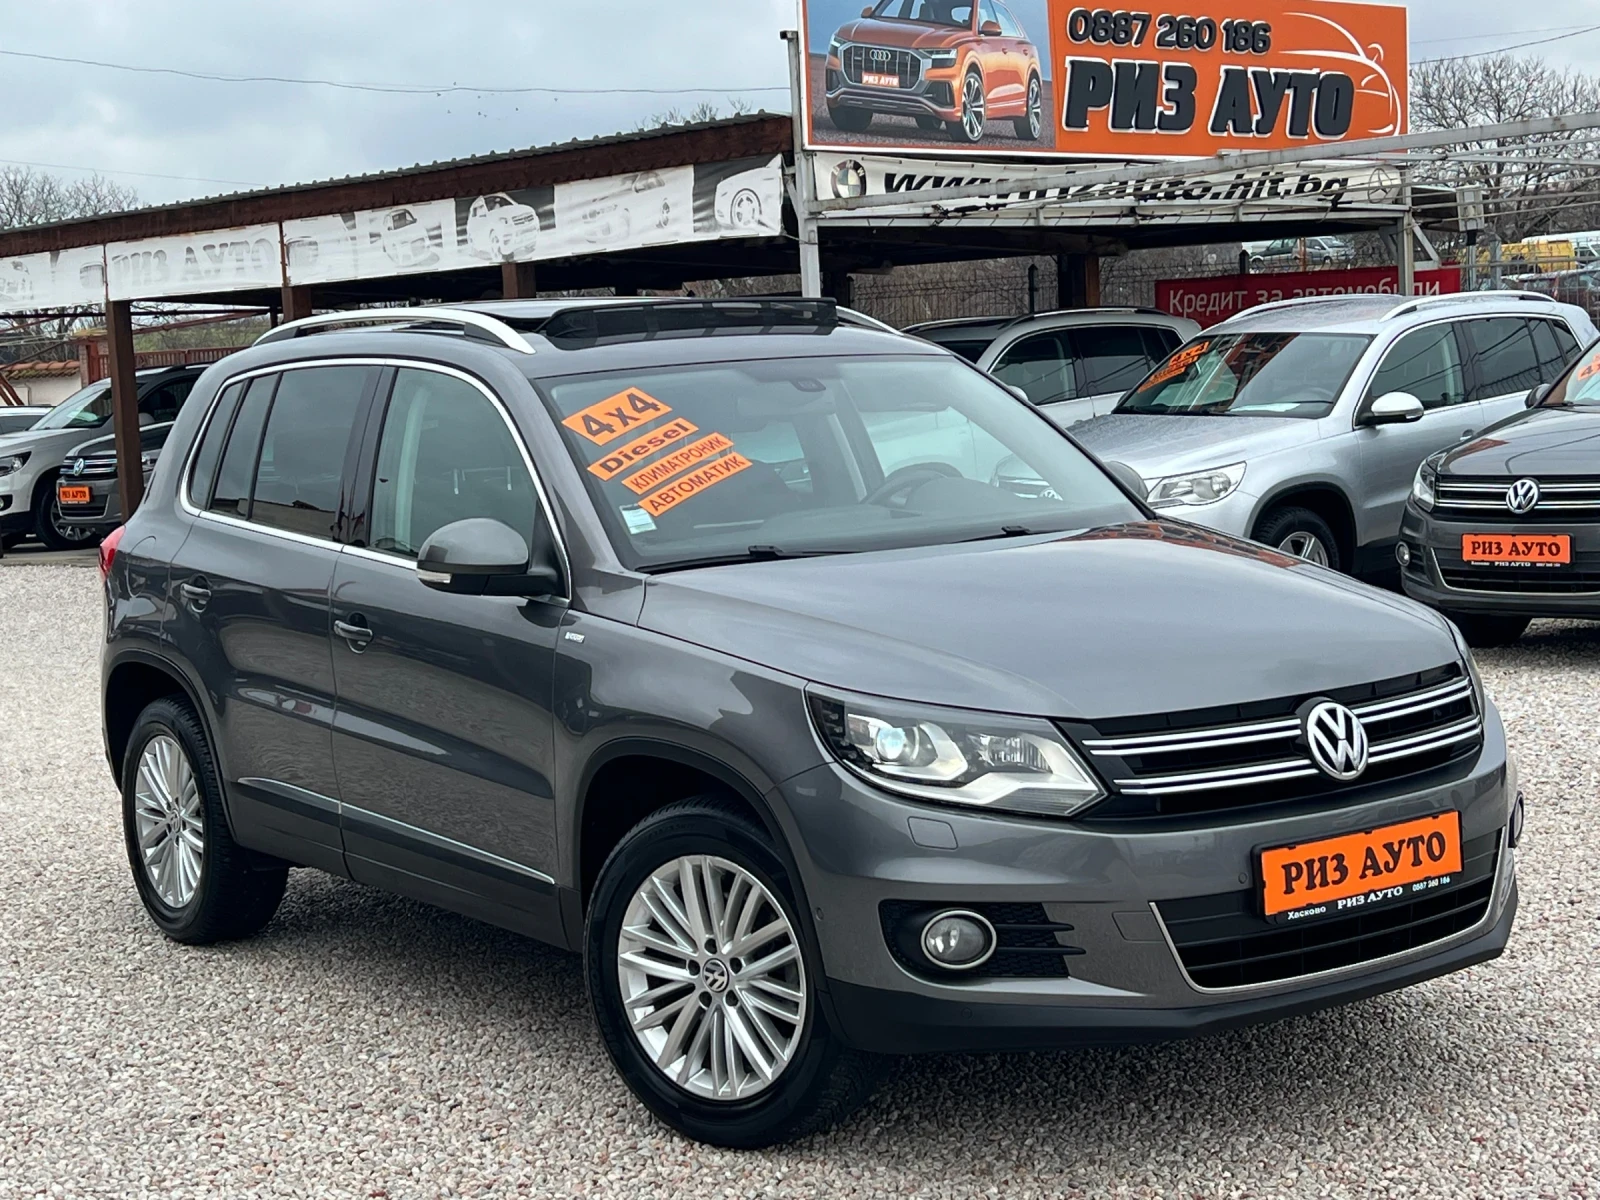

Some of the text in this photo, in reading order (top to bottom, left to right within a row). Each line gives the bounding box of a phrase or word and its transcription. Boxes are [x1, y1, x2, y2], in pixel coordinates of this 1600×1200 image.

[1068, 8, 1272, 55] 0887 260 186
[1062, 56, 1354, 140] РИЗ АУТО
[1169, 289, 1248, 318] Кредит
[599, 422, 690, 473] Diesel
[630, 436, 728, 490] КЛИМАТРОНИК
[649, 455, 746, 511] АВТОМАТИК
[1470, 541, 1561, 556] РИЗ АУТО
[1281, 831, 1446, 895] РИЗ АУТО
[1287, 904, 1327, 920] Хасково
[1337, 894, 1366, 909] РИЗ
[1367, 886, 1403, 903] АУТО
